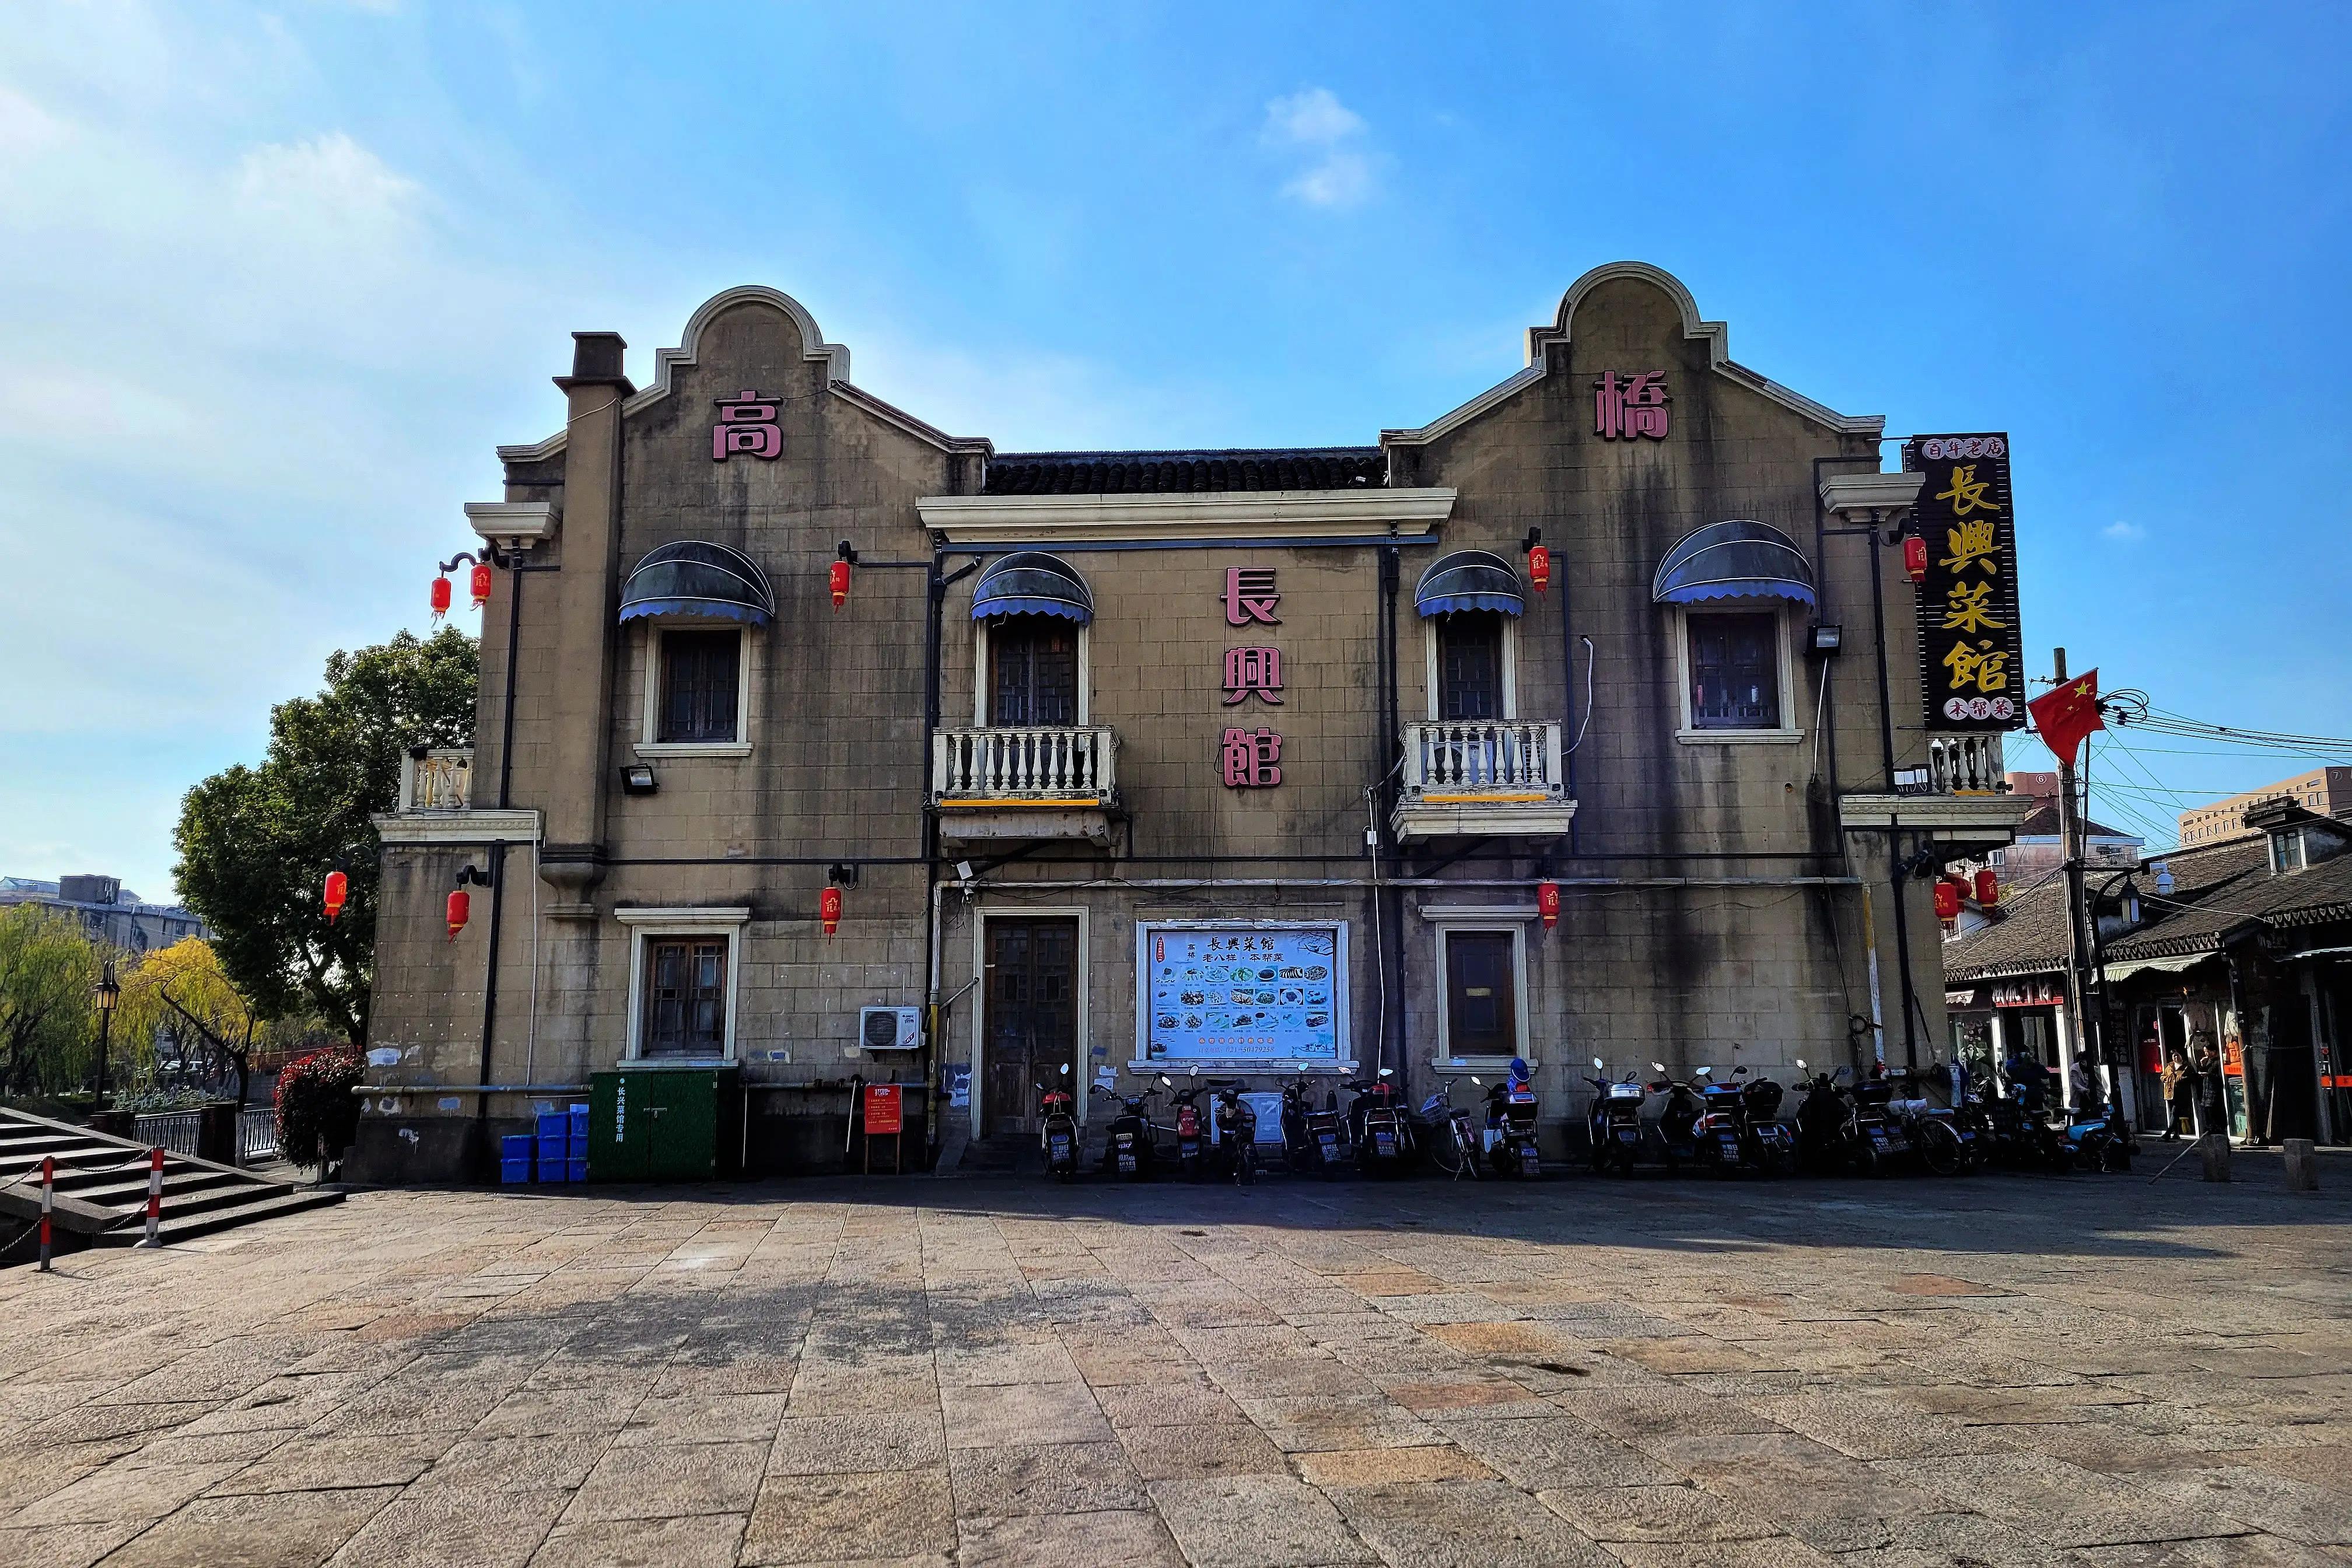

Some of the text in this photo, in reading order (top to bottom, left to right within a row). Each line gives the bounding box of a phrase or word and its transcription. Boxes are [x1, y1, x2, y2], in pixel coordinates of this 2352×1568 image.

[713, 390, 783, 460] 高
[1926, 438, 2003, 457] 百年老店
[1936, 464, 2010, 692] 長興菜館
[1948, 699, 2013, 718] 本帮菜
[1207, 936, 1275, 951] 長興菜館
[616, 1087, 625, 1142] 长兴菜馆专用
